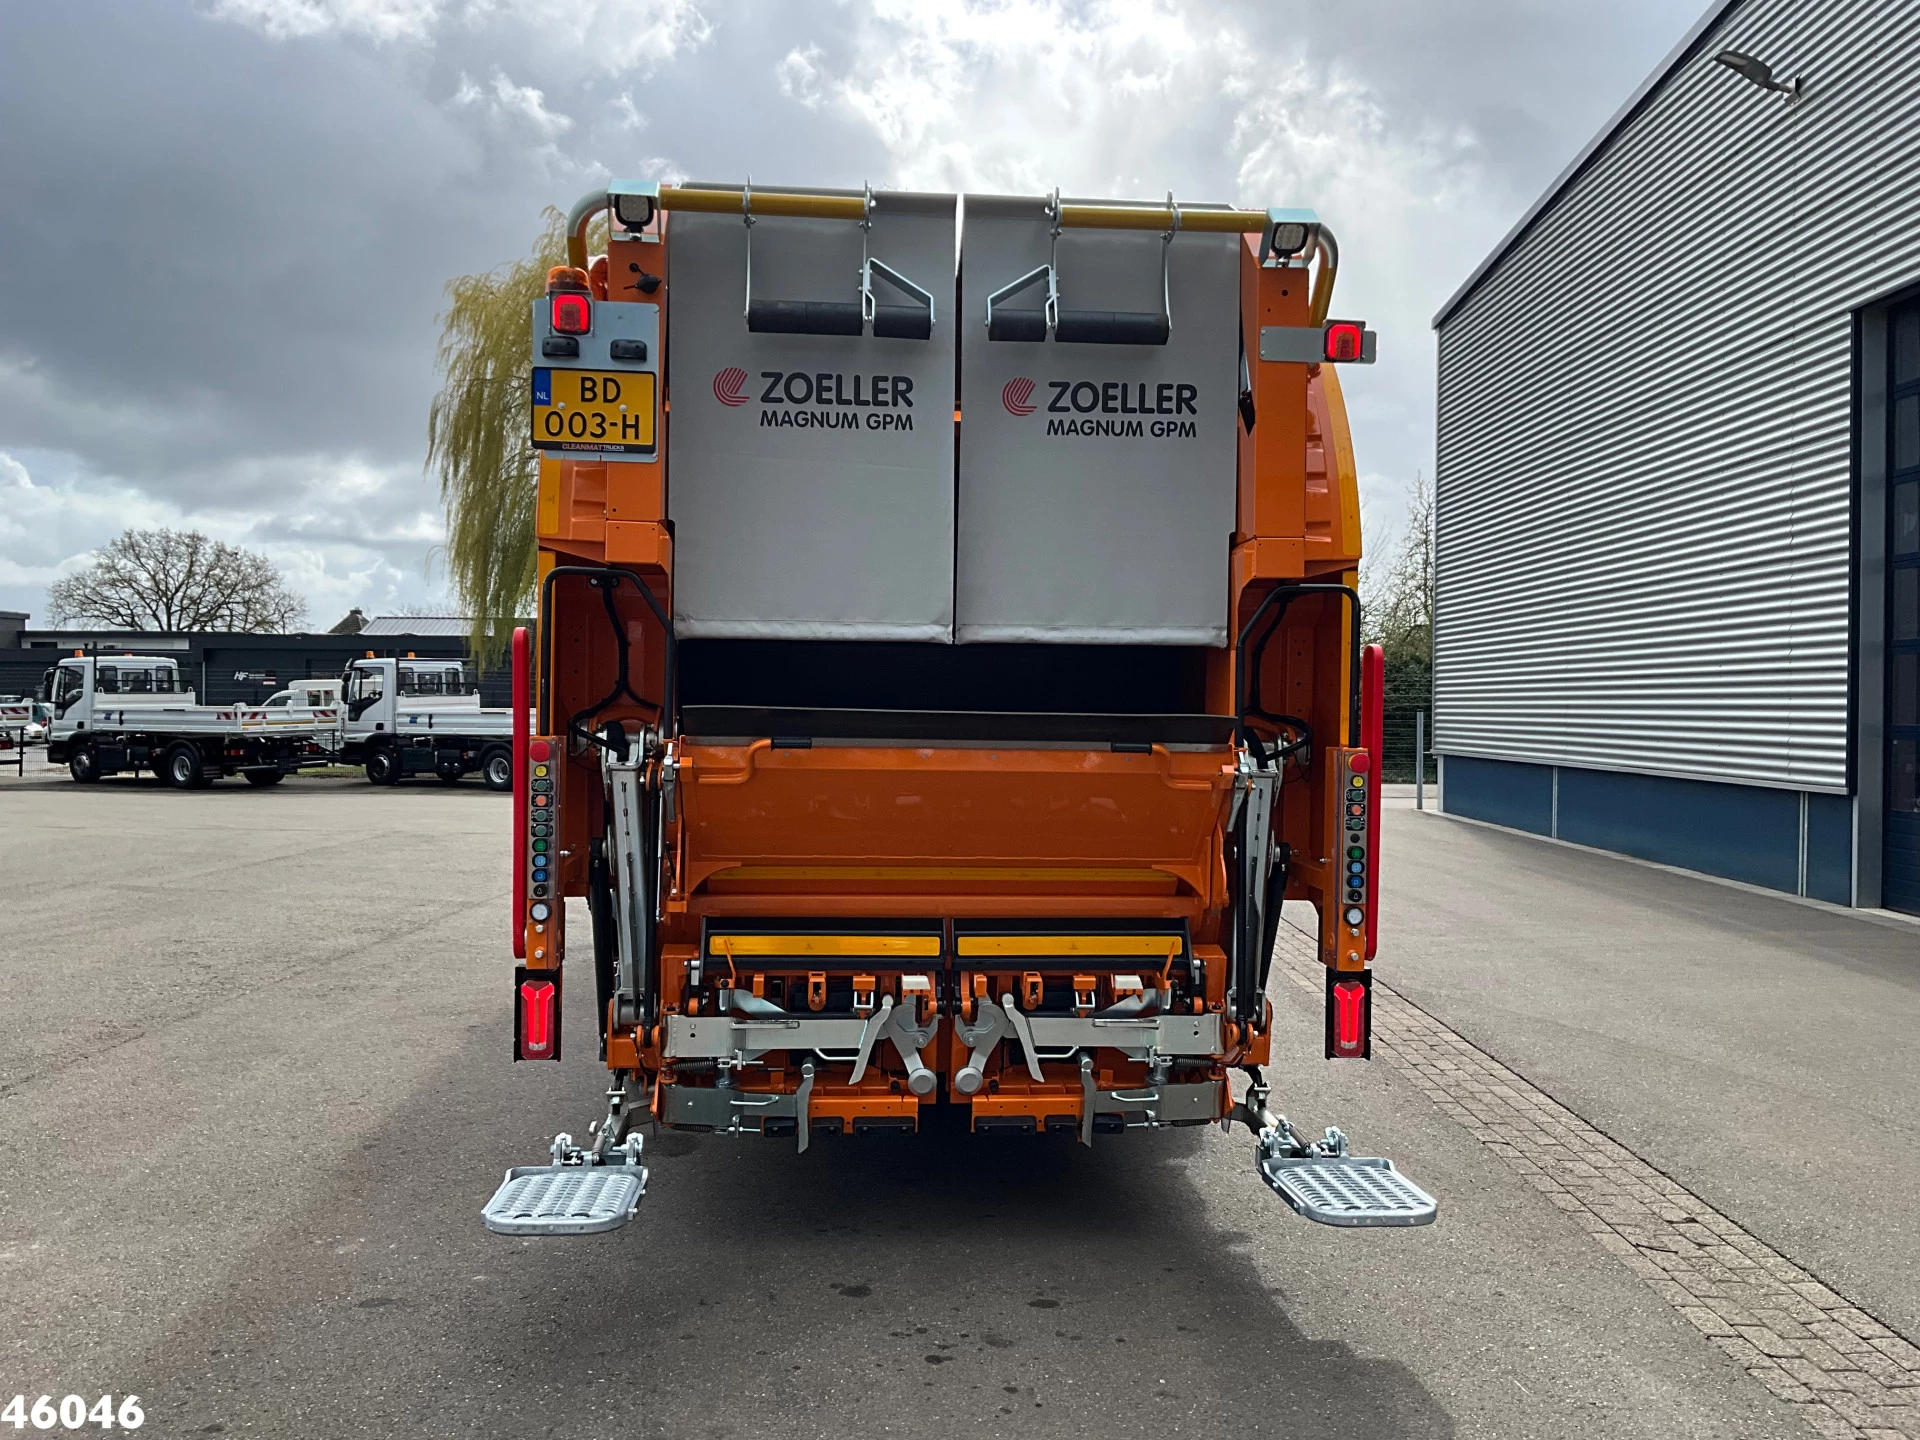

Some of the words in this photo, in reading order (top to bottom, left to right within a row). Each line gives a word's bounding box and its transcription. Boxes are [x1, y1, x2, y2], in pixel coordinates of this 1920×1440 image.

[536, 391, 549, 400] NL
[580, 376, 621, 404] BD
[760, 371, 914, 408] ZOELLER
[1047, 381, 1198, 415] ZOELLER
[545, 410, 640, 440] 003-H
[760, 409, 860, 430] MAGNUM
[866, 413, 914, 431] GPM
[1046, 418, 1144, 437] MAGNUM
[1150, 420, 1197, 438] GPM
